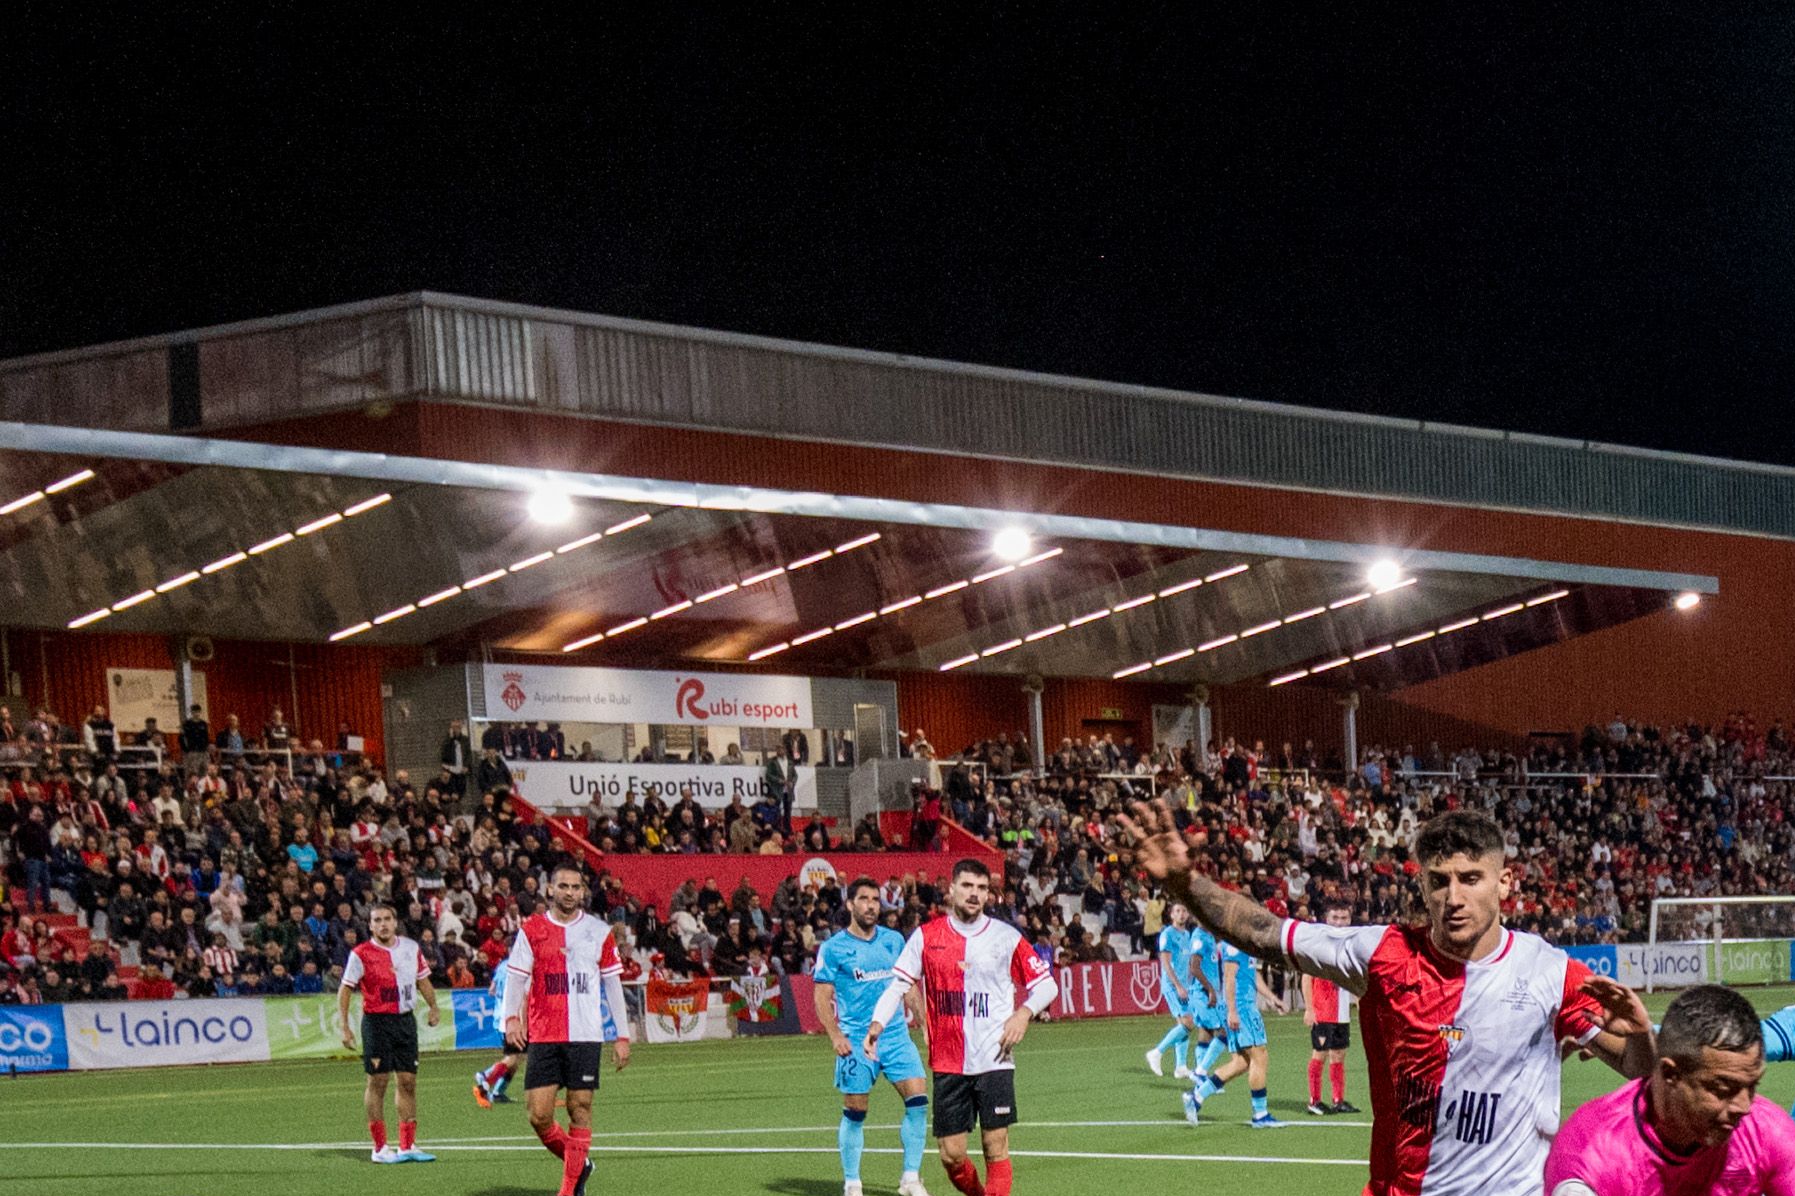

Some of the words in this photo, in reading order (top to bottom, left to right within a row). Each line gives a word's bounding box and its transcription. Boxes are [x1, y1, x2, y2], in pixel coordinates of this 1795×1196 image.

[533, 692, 590, 706] Ajuntament
[594, 692, 607, 705] de
[676, 677, 738, 720] Rubí
[743, 702, 799, 722] esport
[570, 775, 621, 797] Unió
[628, 775, 725, 797] Esportiva
[732, 776, 771, 797] Rub
[1728, 947, 1785, 971] lainco
[1060, 964, 1113, 1014] REY
[120, 1010, 254, 1047] lainco
[1456, 1089, 1502, 1145] HAT
